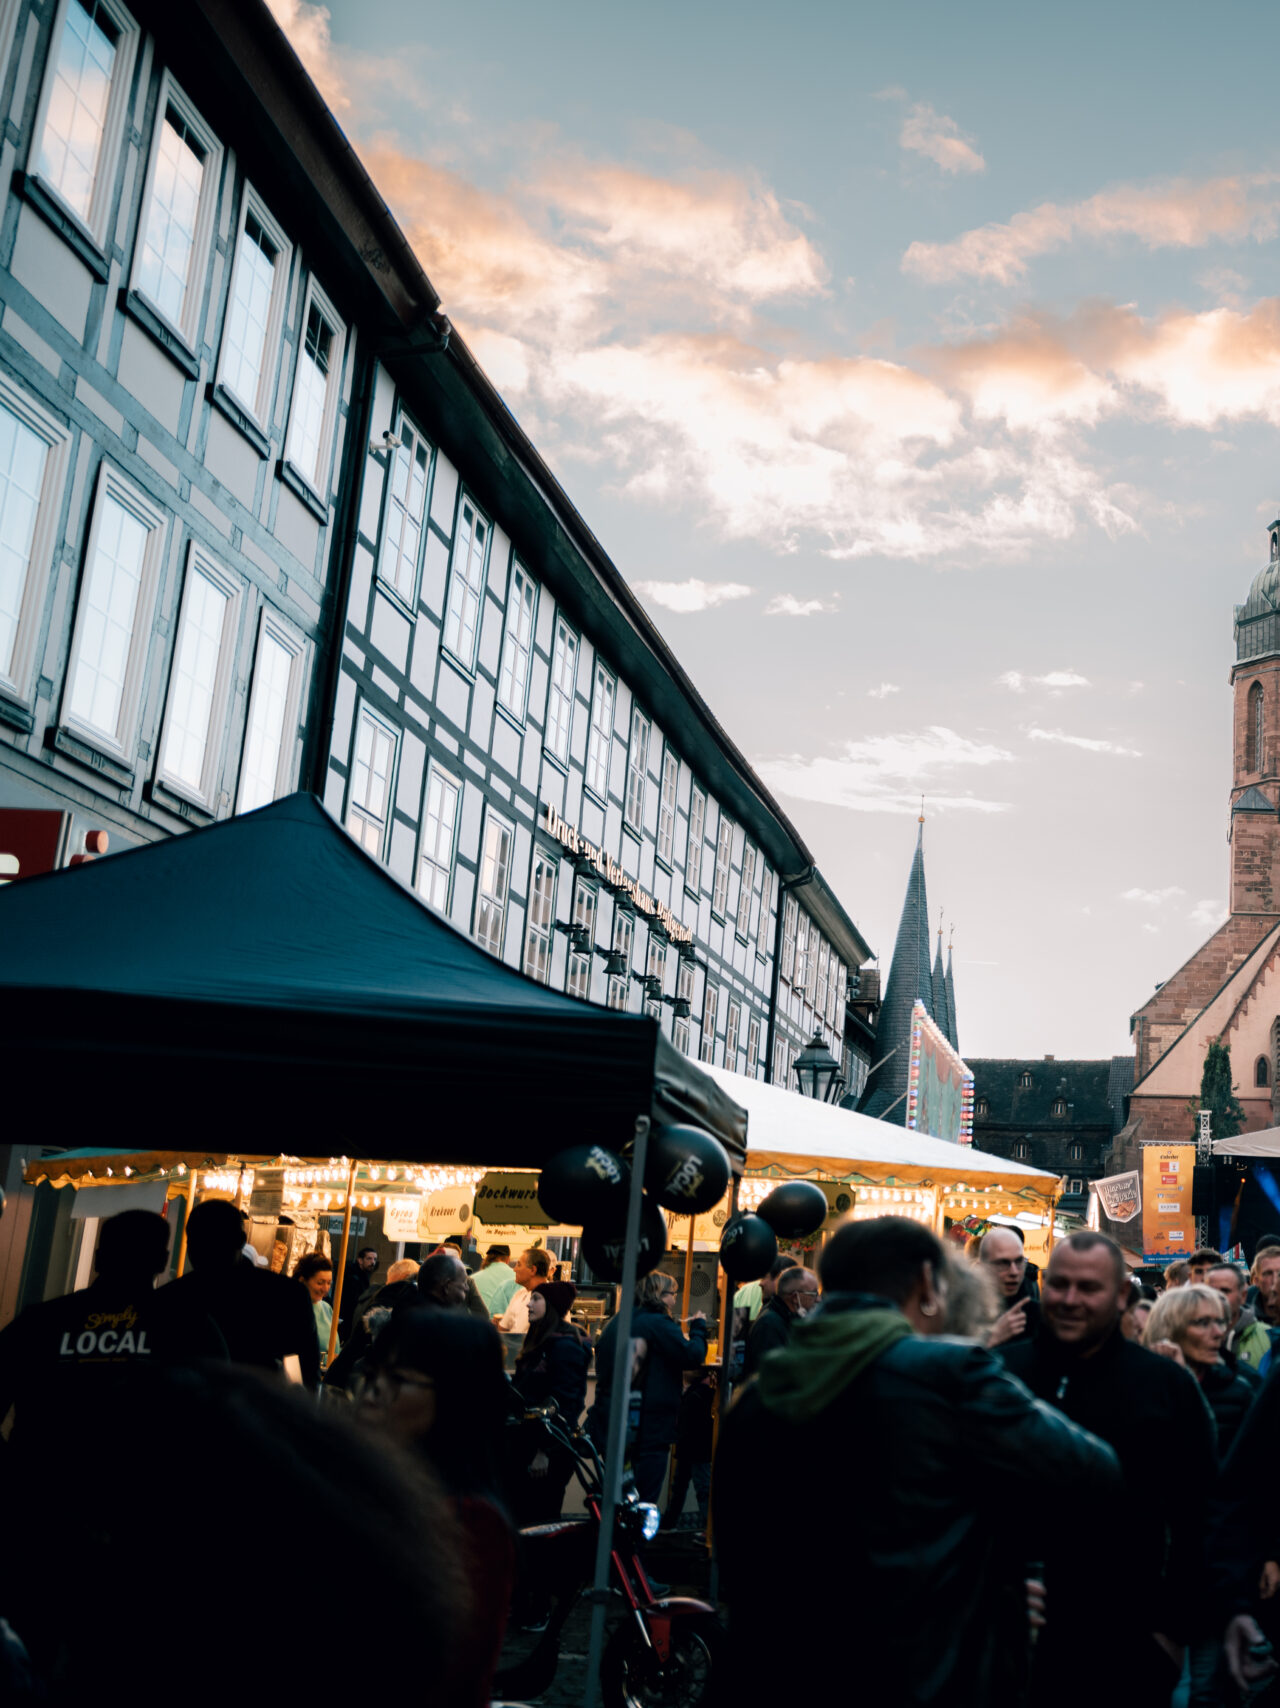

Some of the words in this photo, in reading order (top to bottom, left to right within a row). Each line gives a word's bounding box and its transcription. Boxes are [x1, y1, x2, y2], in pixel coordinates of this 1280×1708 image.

[478, 1185, 537, 1199] Bockwurs
[84, 1304, 139, 1330] Simply
[60, 1330, 151, 1355] LOCAL
